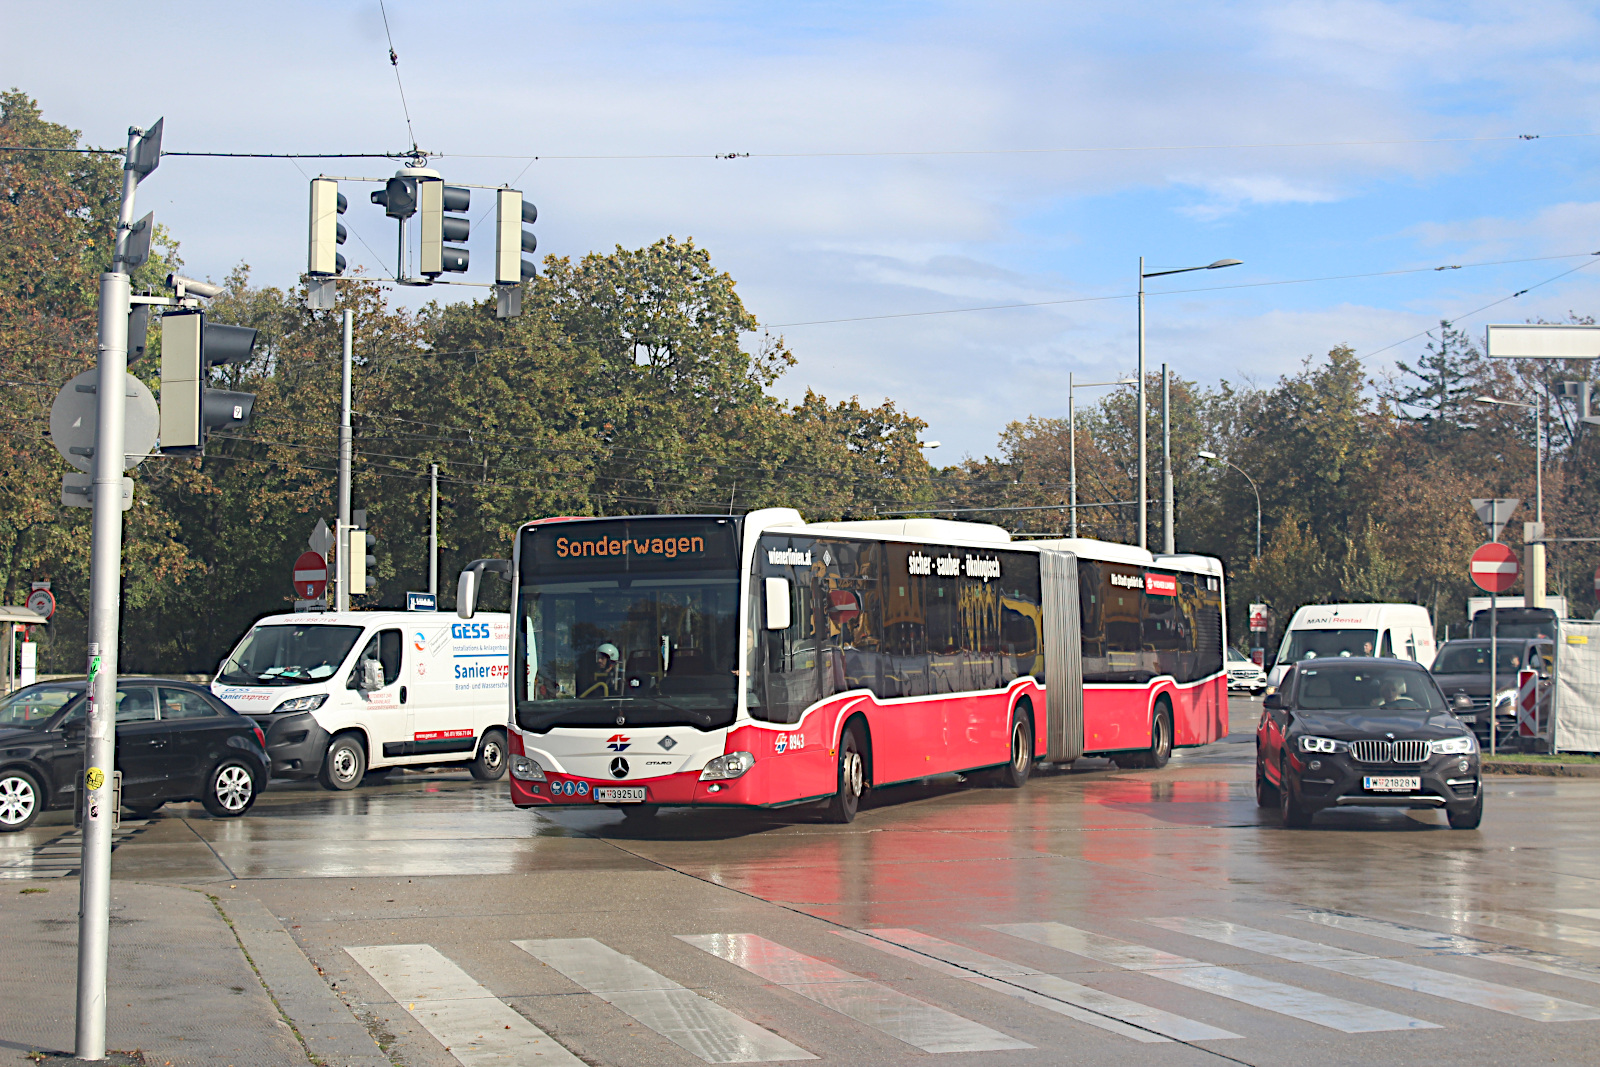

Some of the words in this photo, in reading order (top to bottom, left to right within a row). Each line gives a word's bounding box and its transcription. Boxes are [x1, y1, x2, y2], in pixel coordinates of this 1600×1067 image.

[556, 536, 704, 558] Sonderwagen
[936, 552, 960, 576] sauber
[965, 553, 1001, 582] ökologisch
[451, 623, 490, 639] GESS
[454, 662, 509, 679] Sanierexp
[789, 733, 805, 750] 8943
[1371, 778, 1378, 787] W
[599, 789, 606, 798] W
